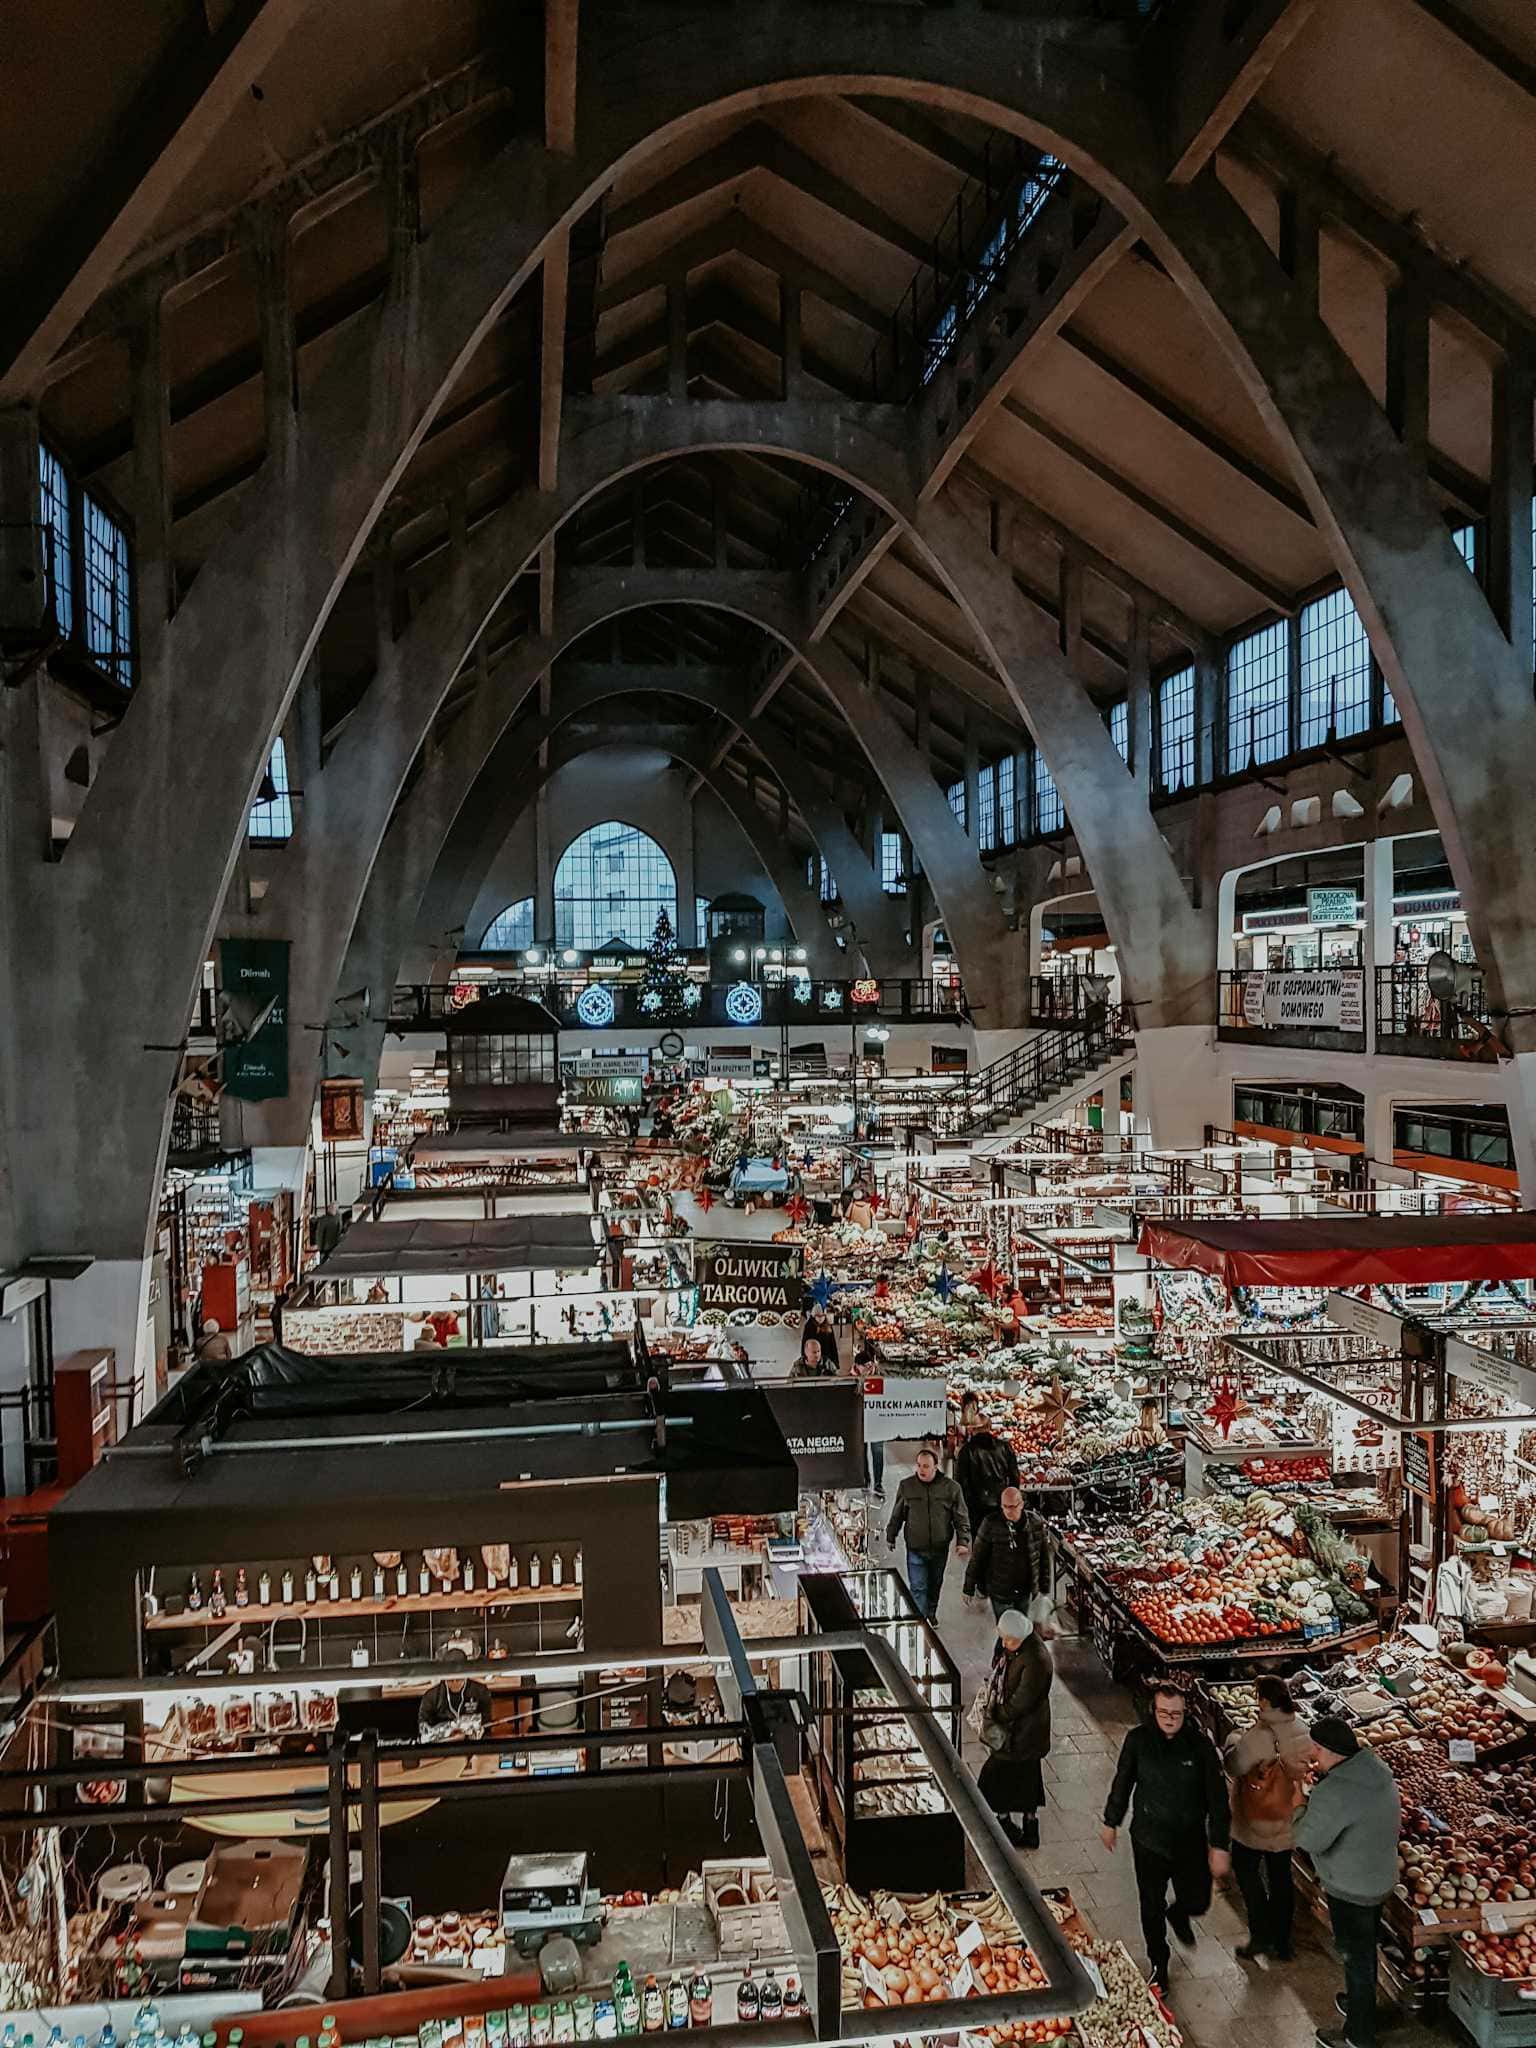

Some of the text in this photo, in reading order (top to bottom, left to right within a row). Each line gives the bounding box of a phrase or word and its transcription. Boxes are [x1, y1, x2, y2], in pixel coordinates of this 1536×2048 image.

[240, 968, 271, 978] Dilmah
[1266, 980, 1281, 997] ART.
[1281, 1001, 1324, 1019] DOMOWEGO
[587, 1080, 638, 1097] KWIATY
[714, 1258, 779, 1278] OLIWKI
[703, 1284, 788, 1305] TARGOWA
[864, 1400, 944, 1409] TURECKI MARKET
[806, 1436, 845, 1448] NEGRA
